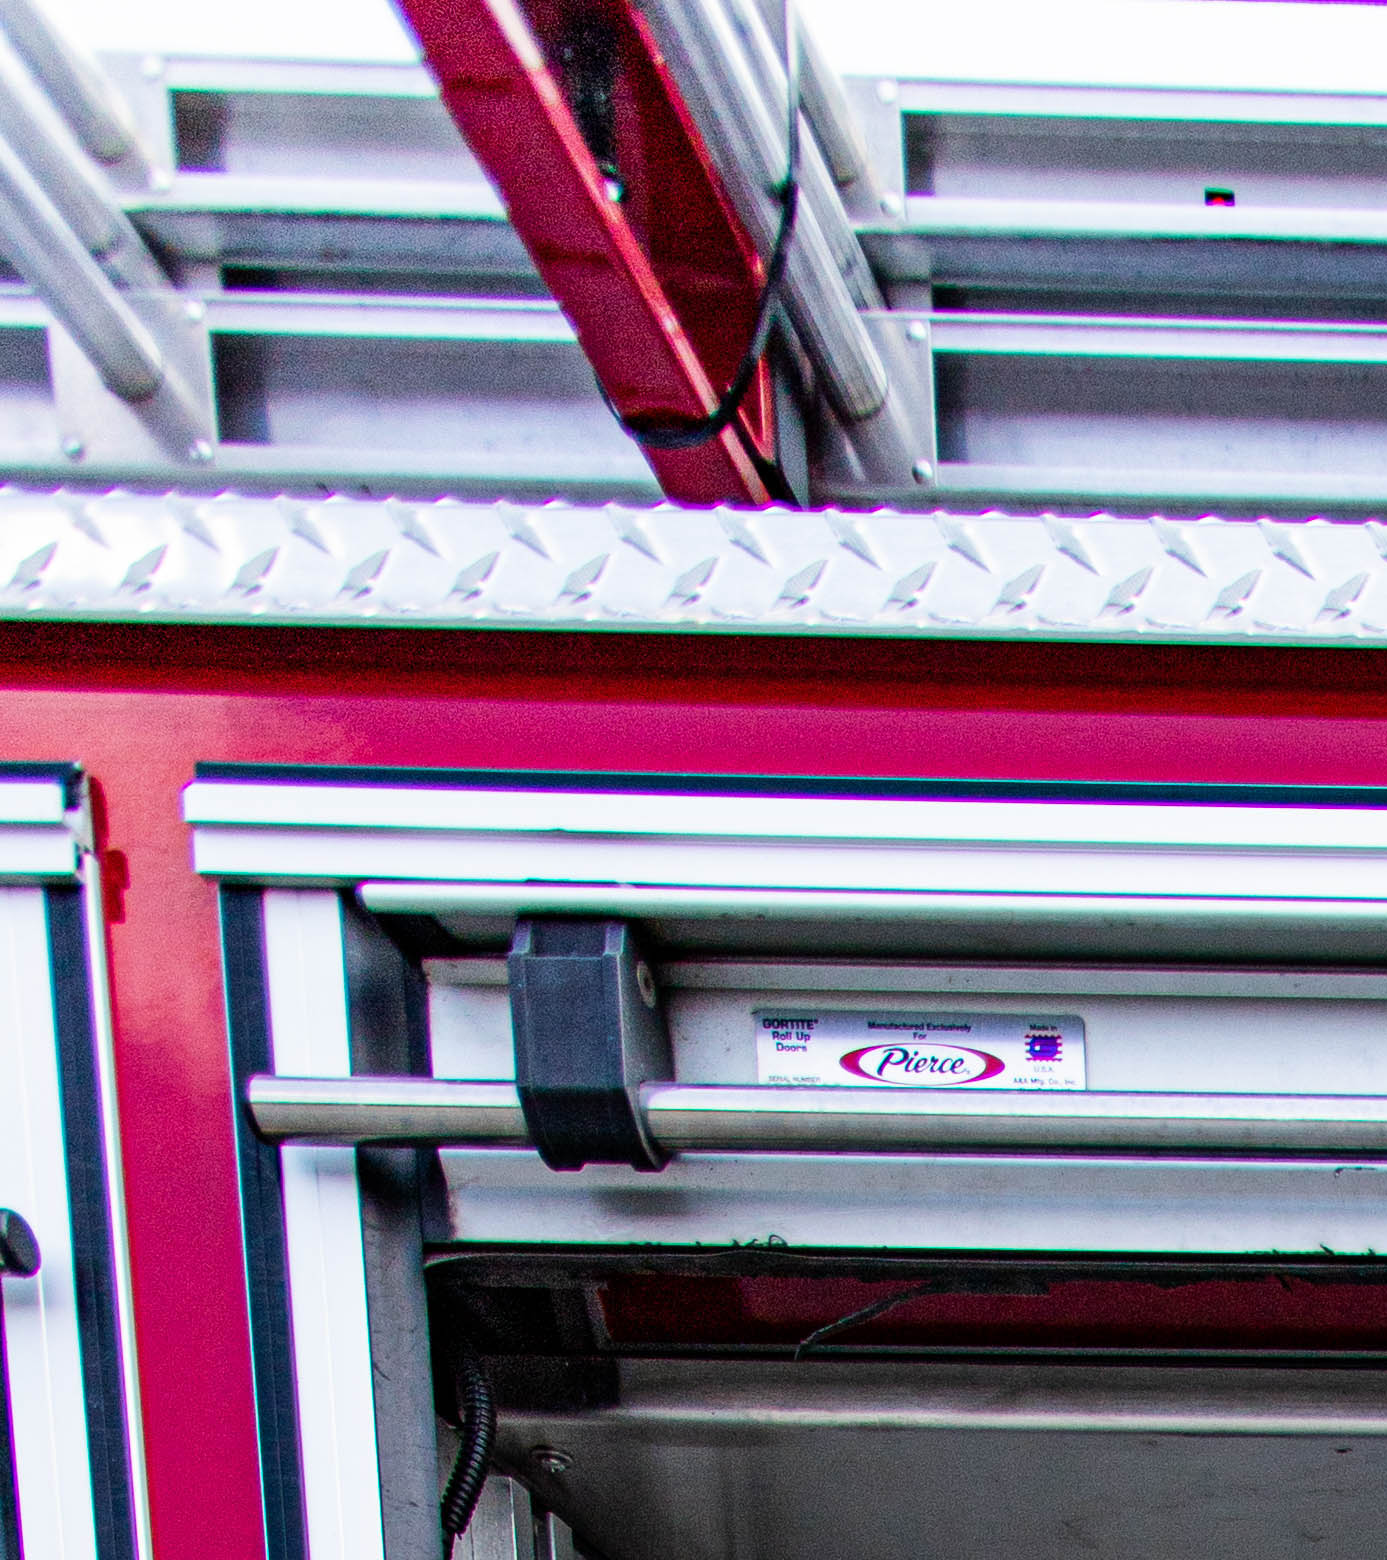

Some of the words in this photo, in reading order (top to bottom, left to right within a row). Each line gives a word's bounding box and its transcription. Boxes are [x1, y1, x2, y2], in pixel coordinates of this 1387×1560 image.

[867, 1021, 924, 1031] Manufactured
[927, 1022, 971, 1033] Exclusively
[772, 1031, 792, 1041] Roll
[796, 1032, 811, 1042] Up
[912, 1032, 927, 1040] For
[776, 1042, 807, 1052] Doors
[876, 1047, 965, 1076] Pierce
